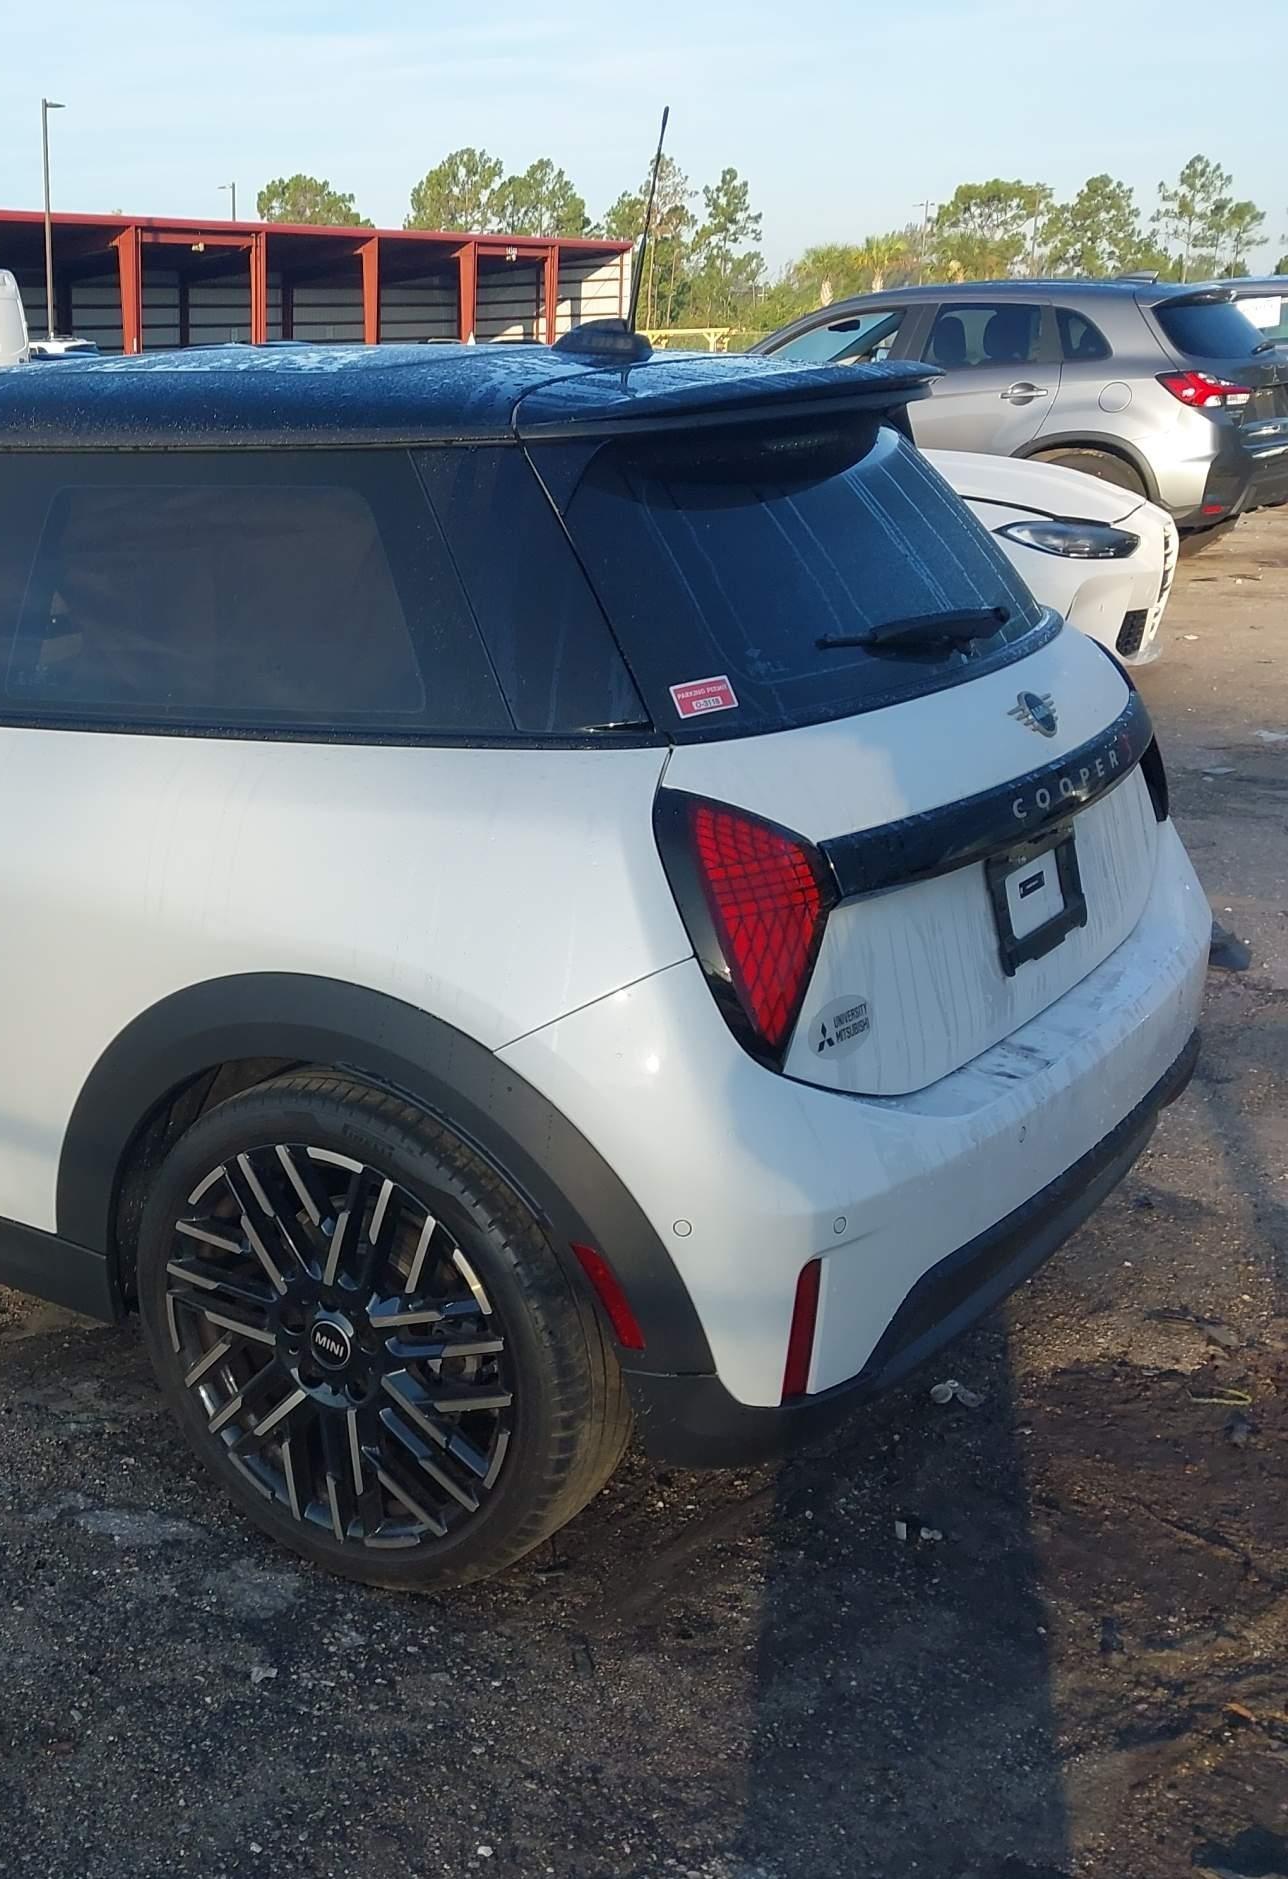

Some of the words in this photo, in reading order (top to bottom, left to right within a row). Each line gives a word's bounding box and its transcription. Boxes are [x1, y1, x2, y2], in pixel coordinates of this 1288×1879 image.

[677, 688, 706, 700] PARKING
[1012, 749, 1120, 819] COOPER
[833, 1002, 867, 1028] UNIVERSITY
[835, 1016, 870, 1043] MITSUBISHI
[315, 1331, 345, 1358] MINI
